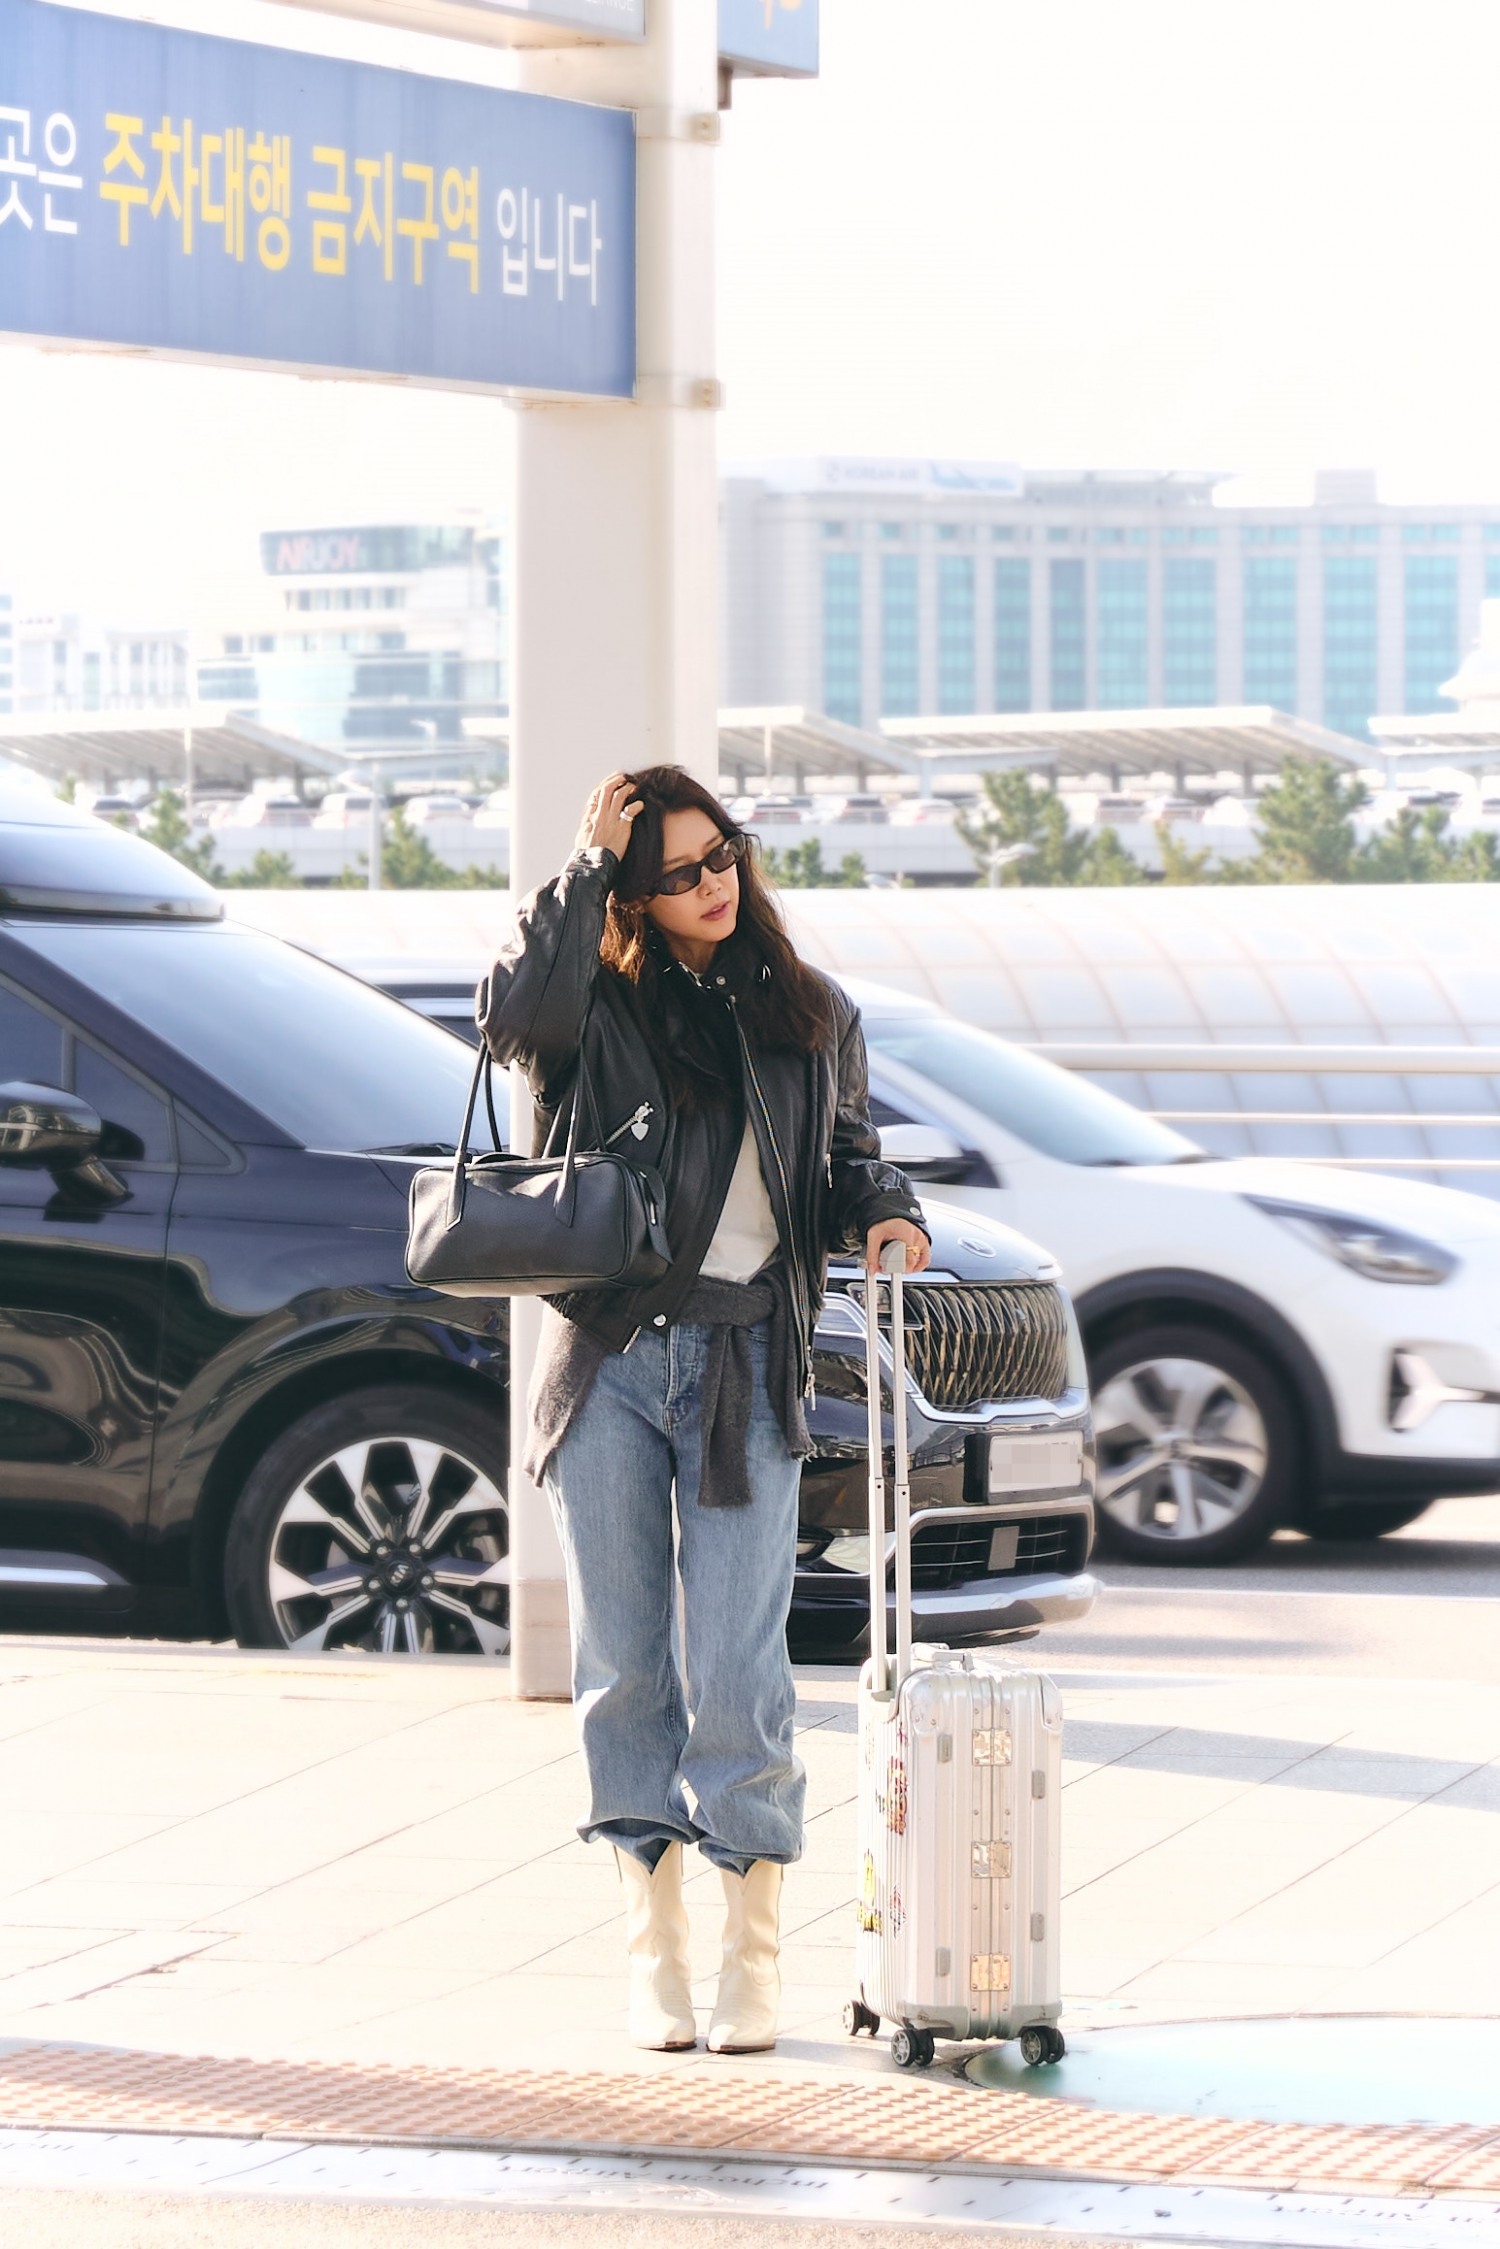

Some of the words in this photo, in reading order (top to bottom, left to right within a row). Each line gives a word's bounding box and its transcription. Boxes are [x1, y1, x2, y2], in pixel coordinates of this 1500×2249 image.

[99, 111, 290, 272] 주차대행
[306, 145, 479, 295] 금지구역
[496, 187, 602, 306] 입니다
